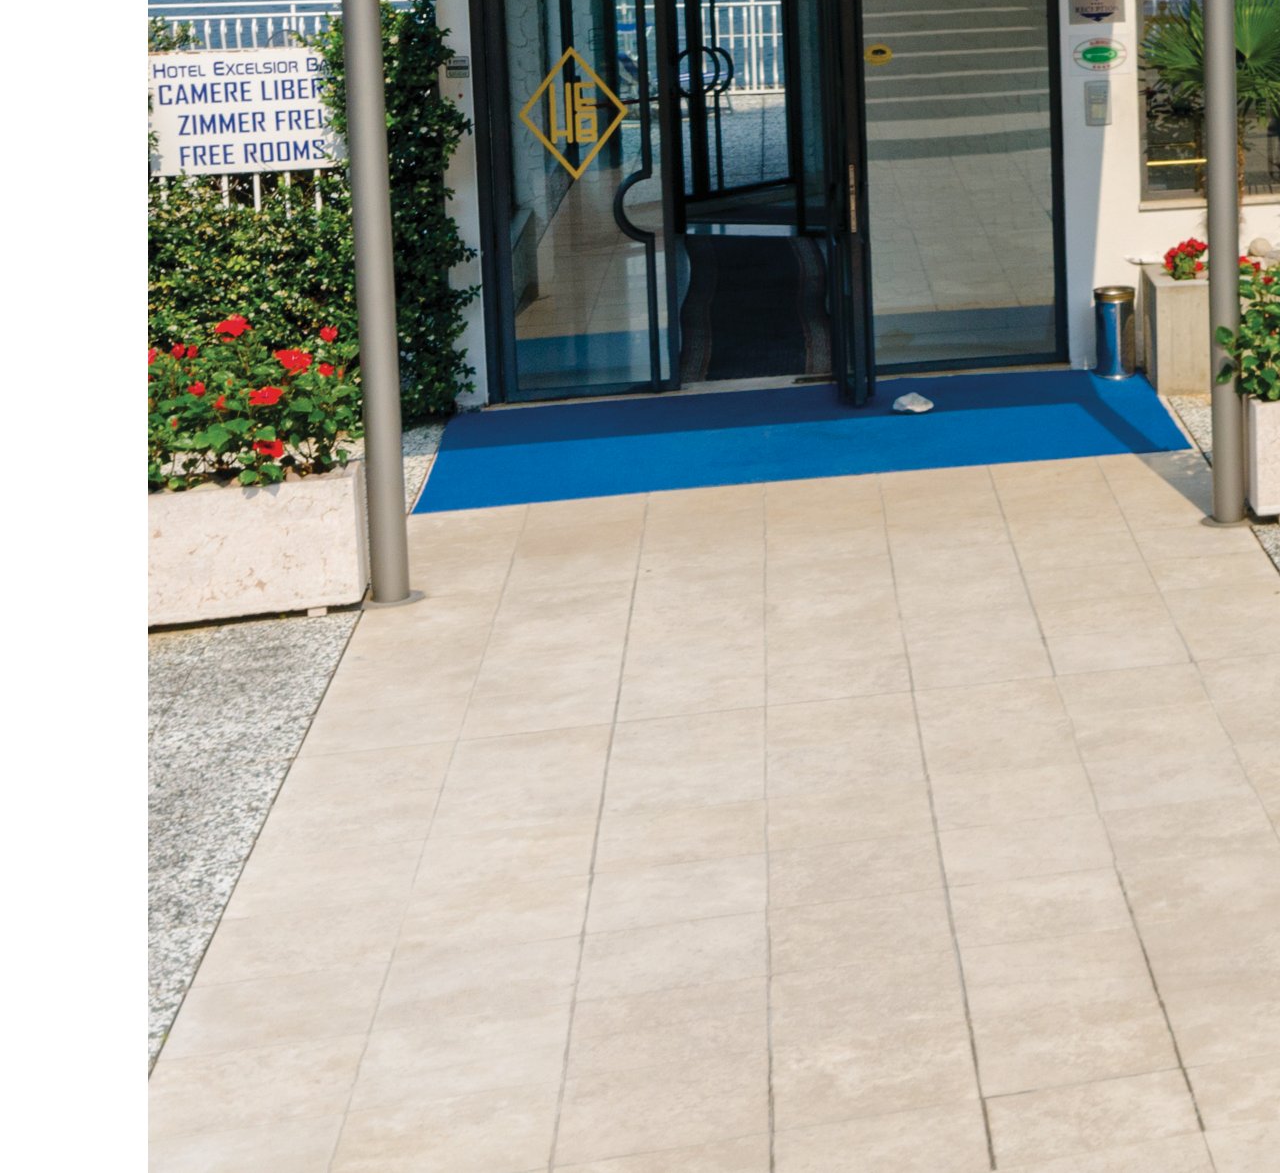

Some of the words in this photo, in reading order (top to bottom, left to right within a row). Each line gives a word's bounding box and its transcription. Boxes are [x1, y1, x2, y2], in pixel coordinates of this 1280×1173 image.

[153, 62, 206, 79] HOTEL
[213, 59, 299, 76] EXCELSIOR
[158, 81, 252, 106] CAMERE
[261, 77, 336, 102] LIBER
[178, 111, 266, 136] ZIMMER
[179, 143, 235, 167] FREE
[244, 139, 326, 164] ROOMS
